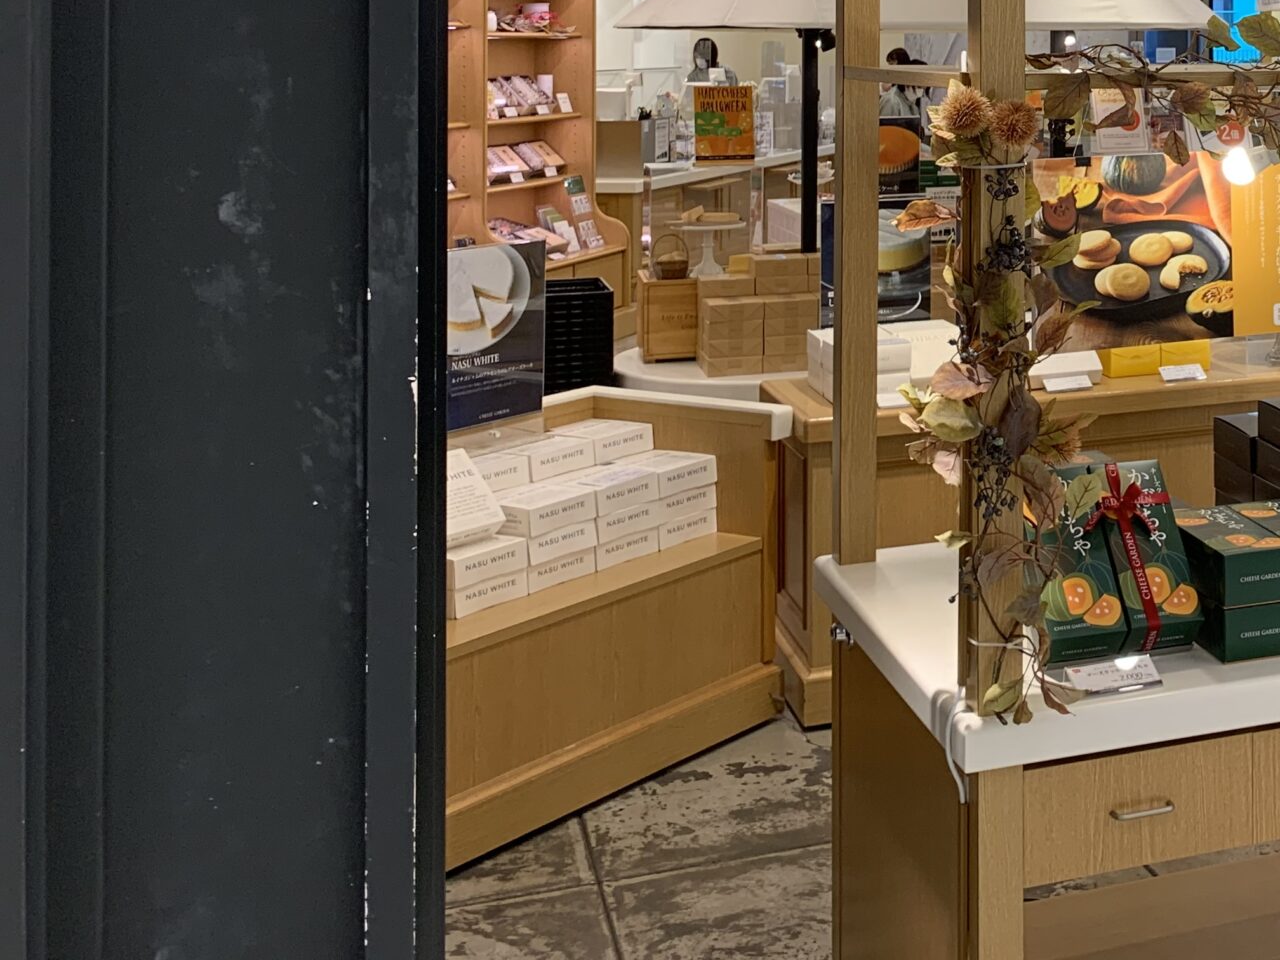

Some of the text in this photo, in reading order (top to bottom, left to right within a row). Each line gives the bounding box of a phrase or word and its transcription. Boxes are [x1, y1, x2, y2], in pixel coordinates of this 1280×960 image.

[699, 100, 747, 113] HALLOWEEN
[451, 353, 500, 371] NASU WHITE
[602, 433, 644, 449] NASU WHITE
[540, 448, 584, 467] NASU WHITE
[448, 468, 475, 481] HITE
[493, 466, 518, 477] WHITE
[666, 465, 708, 483] NASU WHITE
[605, 482, 649, 501] NASU WHITE
[666, 491, 707, 509] NASU WHITE
[539, 500, 585, 520] NASU WHITE
[606, 508, 649, 528] NASU WHITE
[666, 516, 708, 535] NASU WHITE
[538, 527, 586, 548] NASU WHITE
[605, 535, 649, 555] NASU WHITE
[464, 550, 516, 572] NASU WHITE
[537, 556, 585, 577] NASU WHITE
[1124, 531, 1151, 600] CHEESE GARDEN
[1239, 574, 1260, 583] CHEESE
[464, 578, 517, 601] NASU WHITE
[1240, 629, 1260, 639] CHEESE
